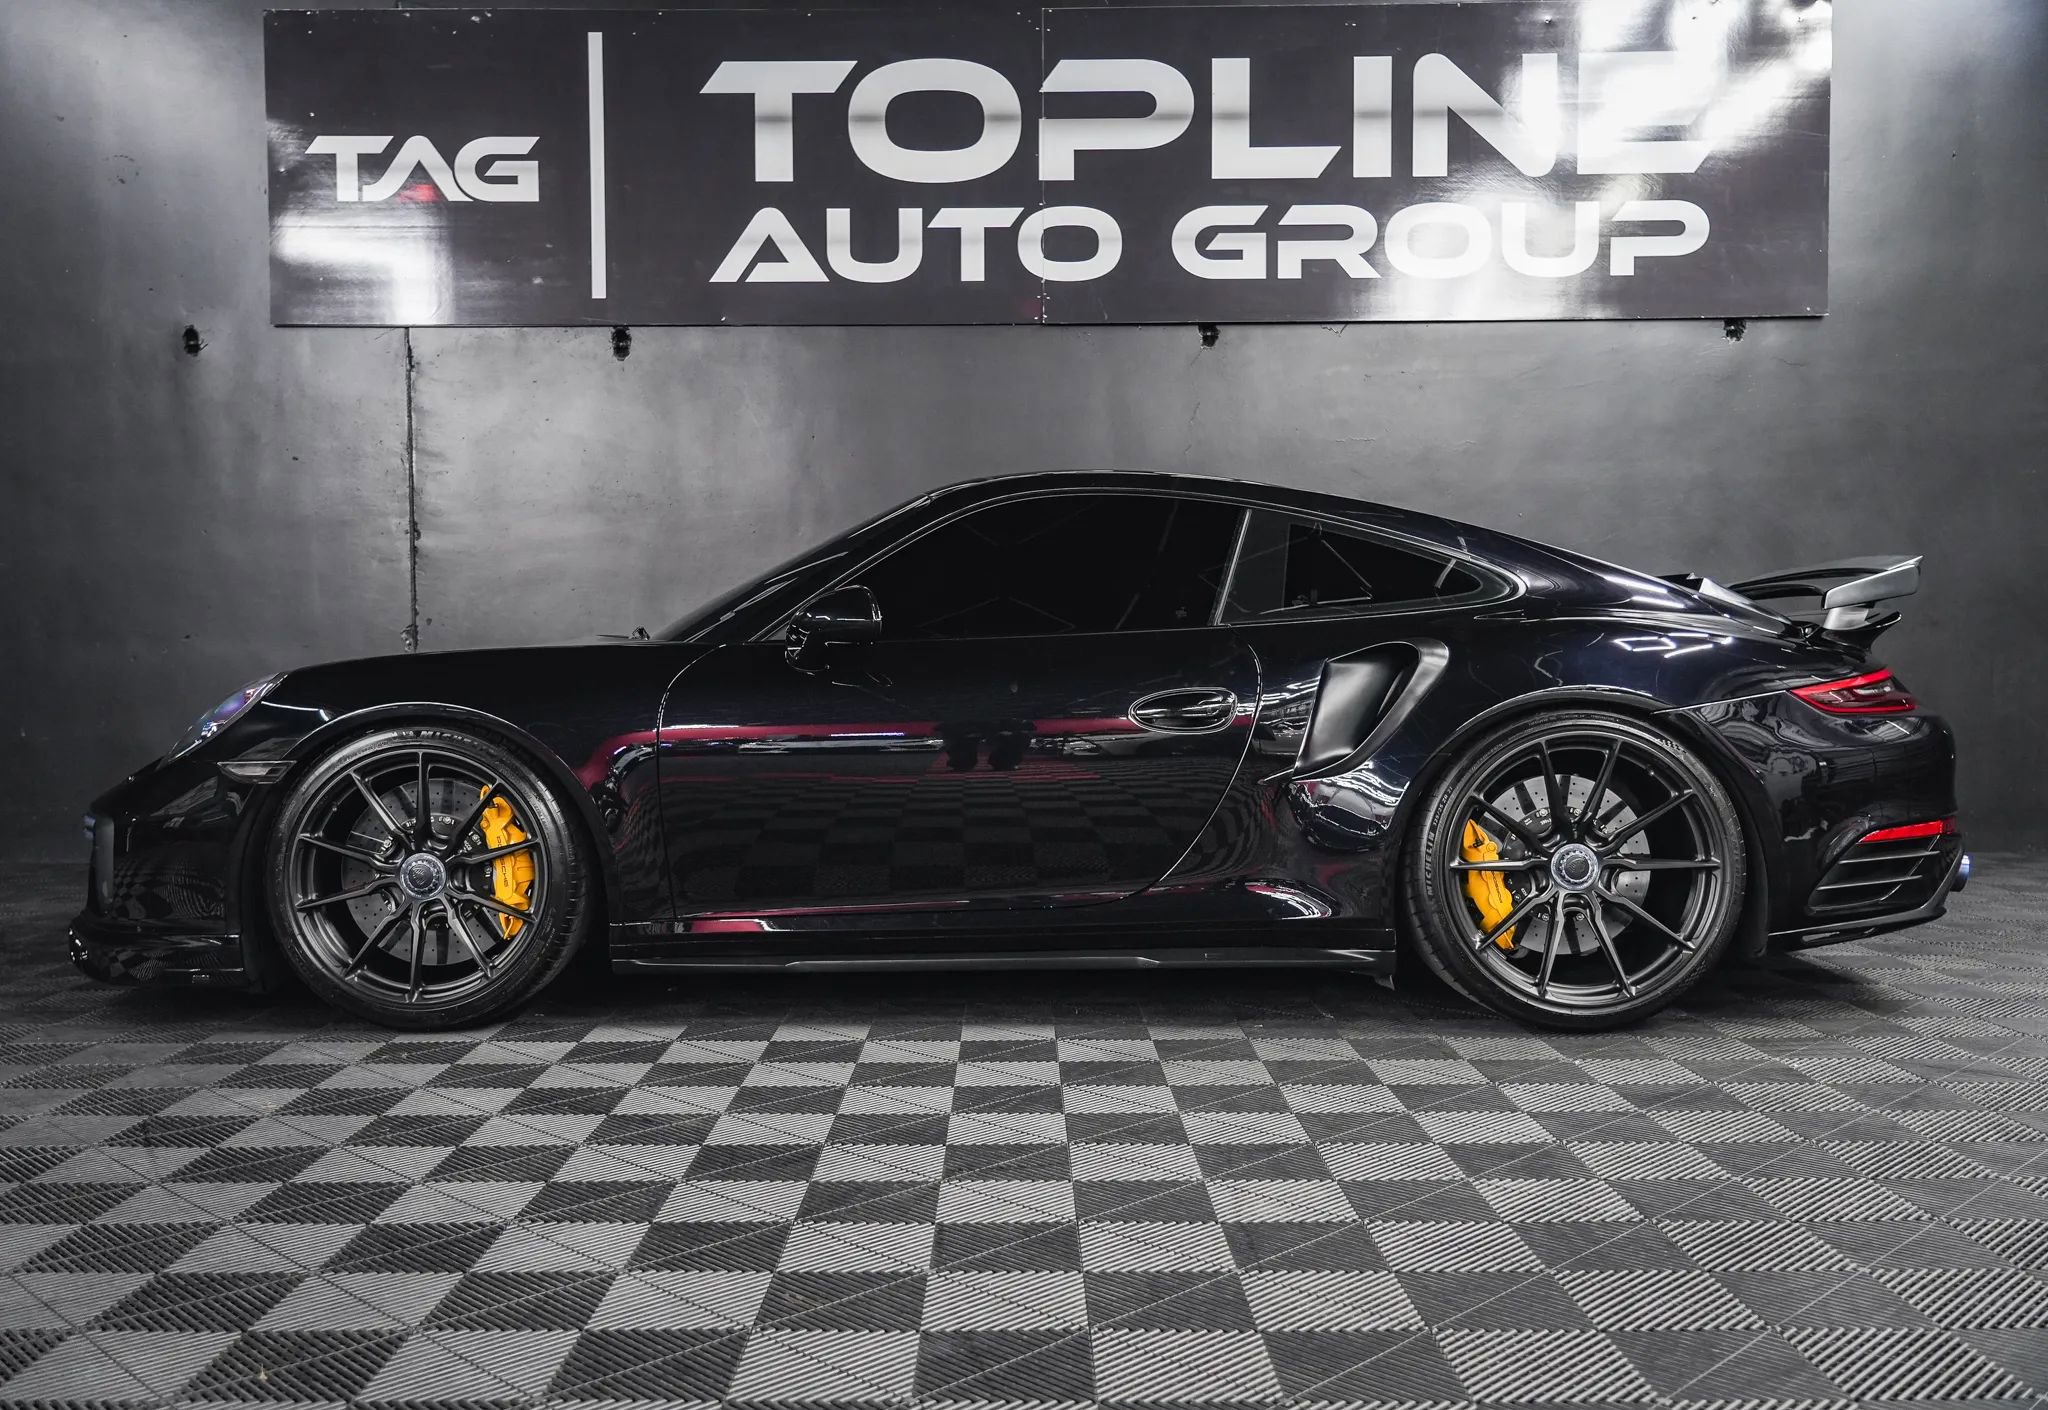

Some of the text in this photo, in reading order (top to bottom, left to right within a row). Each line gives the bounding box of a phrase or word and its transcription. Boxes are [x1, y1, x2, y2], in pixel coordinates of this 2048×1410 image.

[700, 51, 1716, 183] TOPLINE
[305, 135, 540, 202] TAG
[709, 200, 1710, 283] AUTO GROUP
[496, 835, 509, 888] POSCHE
[1425, 831, 1435, 896] MICHELIN
